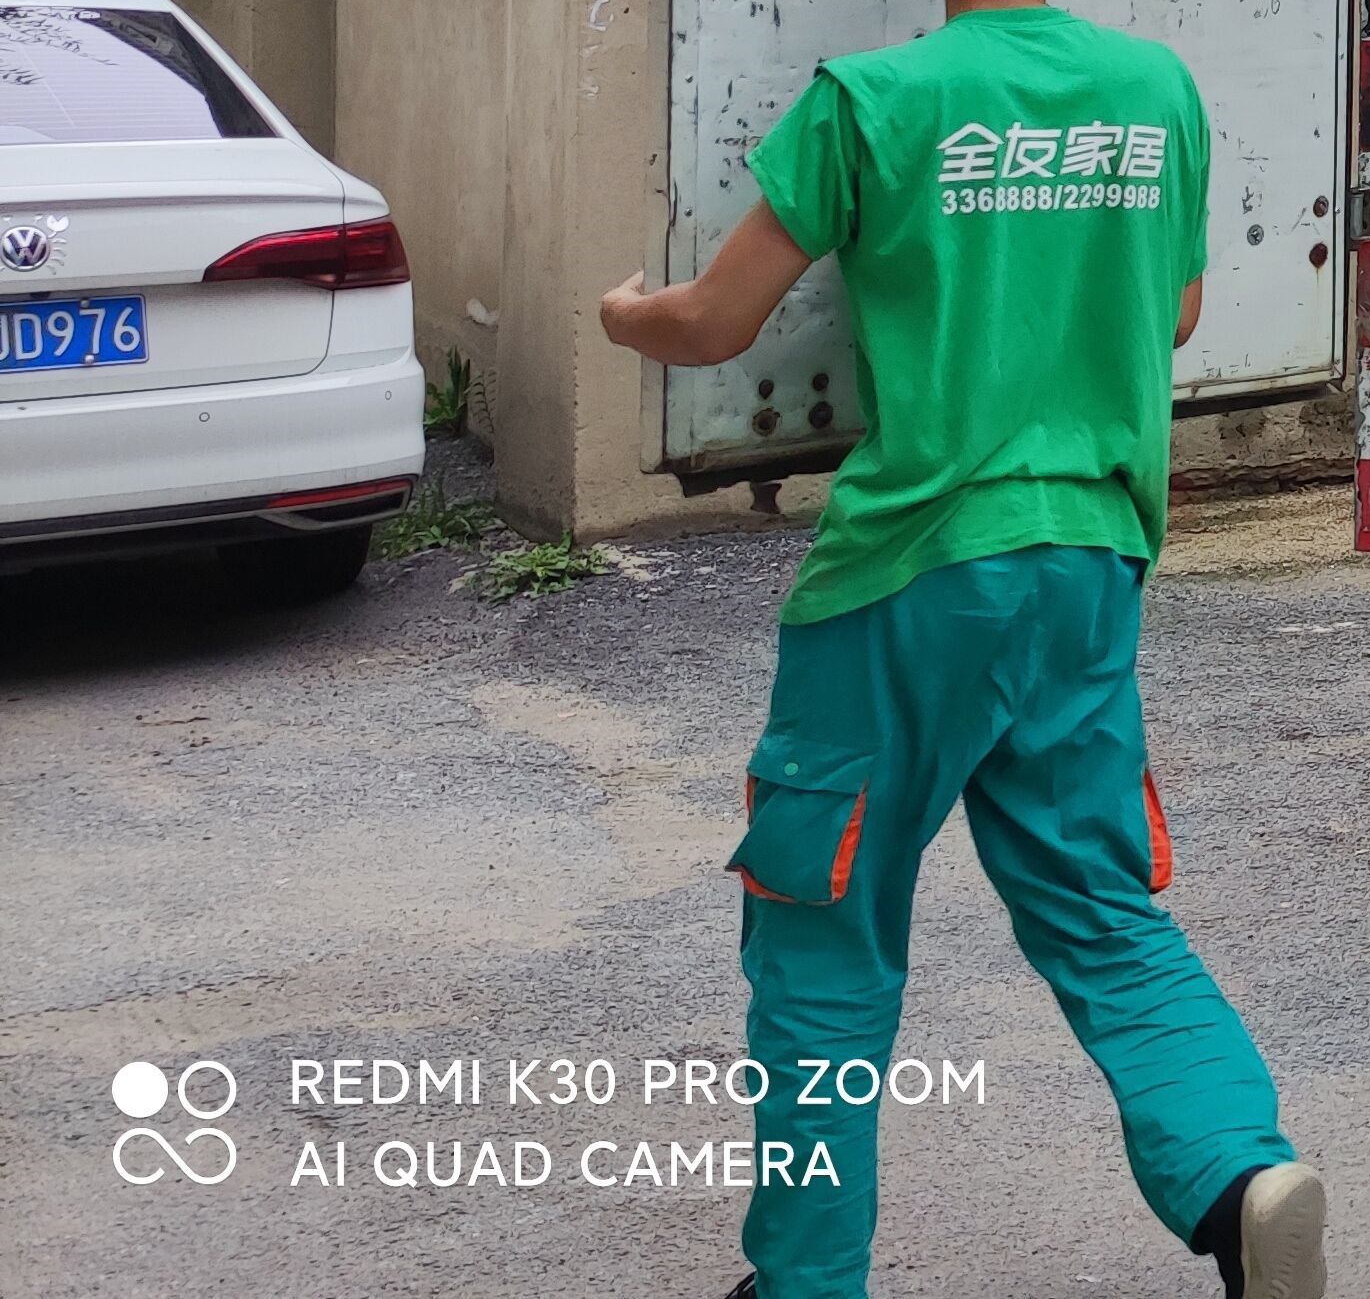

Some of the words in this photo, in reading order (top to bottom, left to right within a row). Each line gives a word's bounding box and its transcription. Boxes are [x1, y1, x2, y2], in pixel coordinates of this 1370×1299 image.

[937, 121, 1168, 183] 全友家居
[941, 183, 1162, 216] 3368888/2299988
